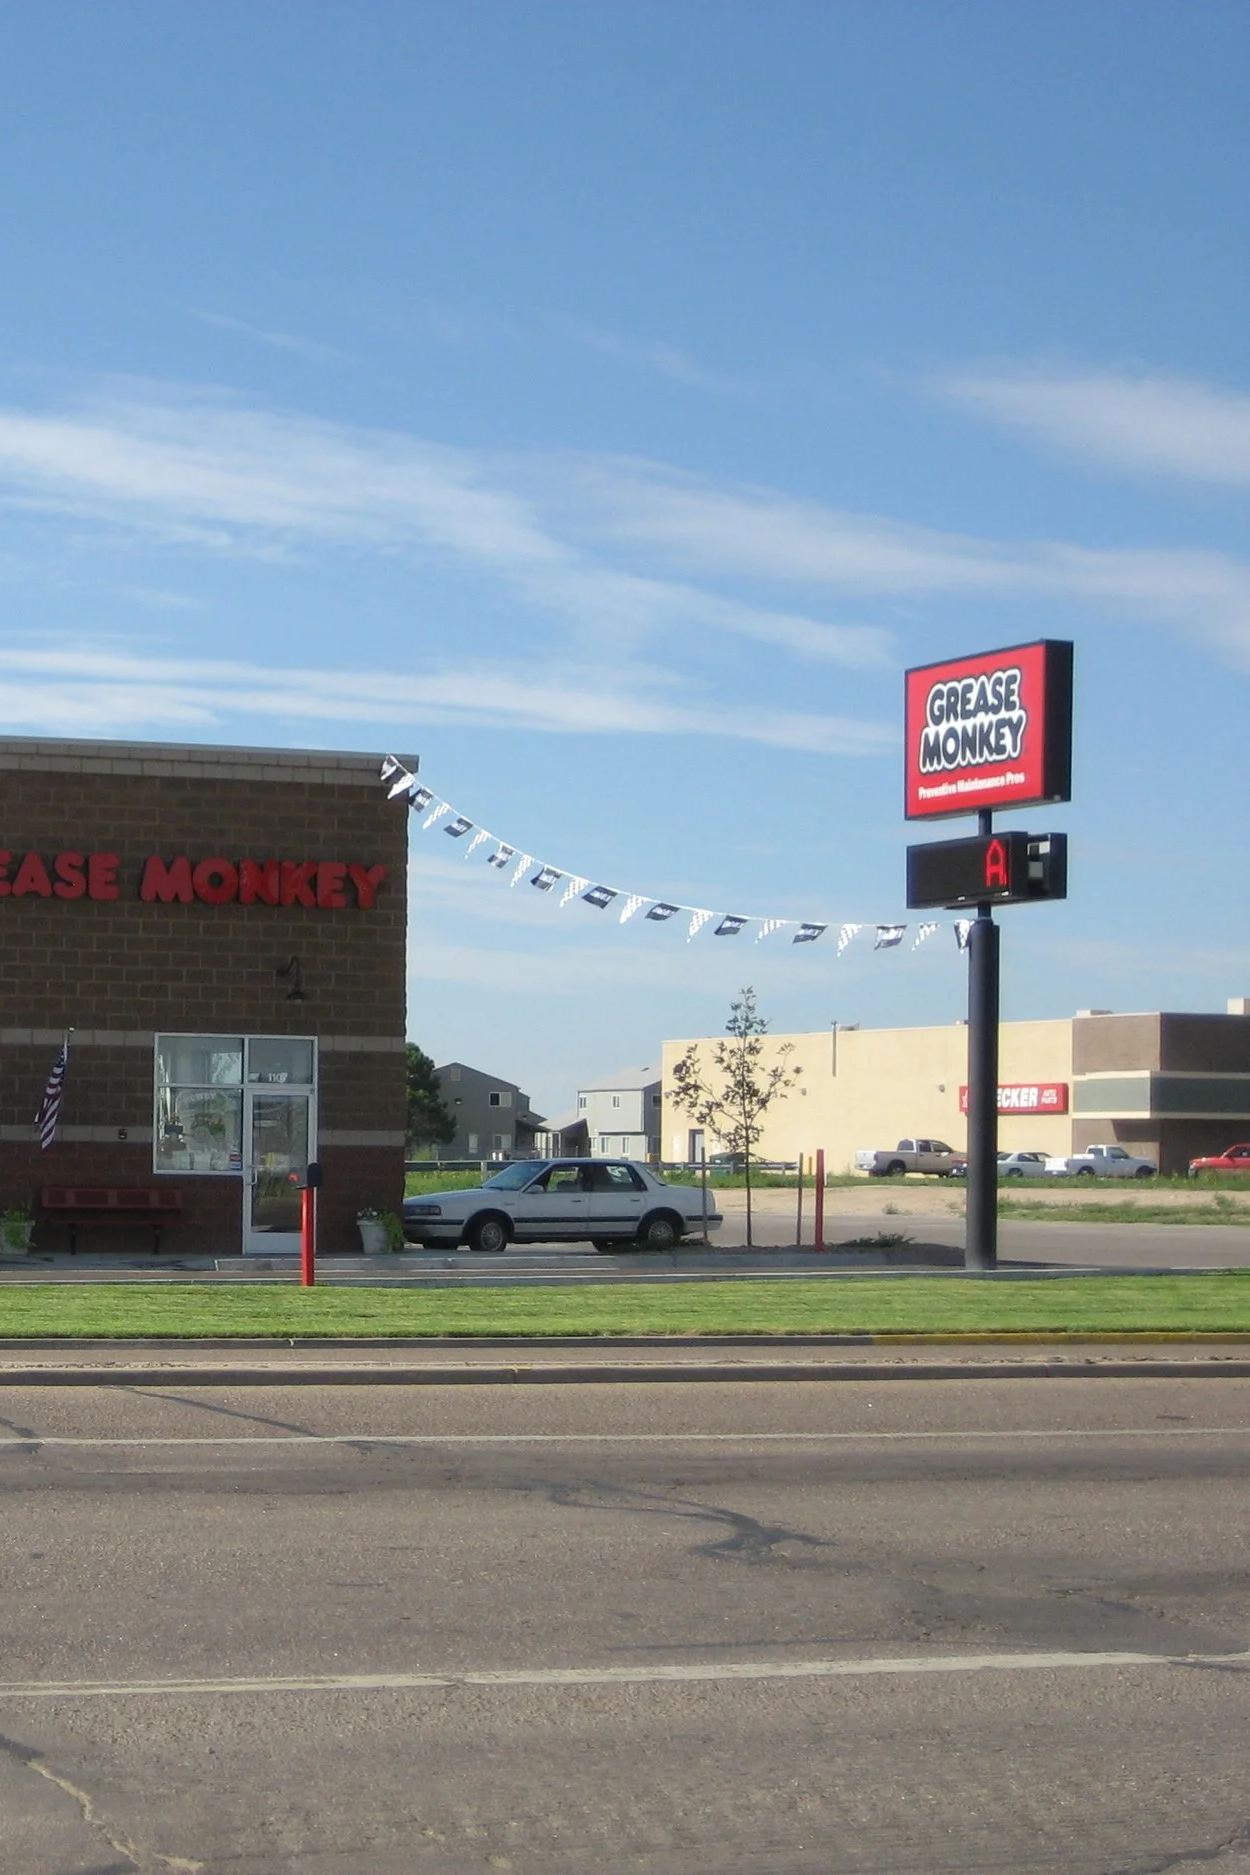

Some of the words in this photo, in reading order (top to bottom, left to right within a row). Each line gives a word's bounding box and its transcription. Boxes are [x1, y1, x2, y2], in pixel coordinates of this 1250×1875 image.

[926, 668, 1021, 728] GREASE
[919, 709, 1027, 774] MONKEY
[918, 783, 957, 800] Preventive
[957, 775, 1006, 793] Maintenance
[1006, 771, 1025, 786] Pros
[141, 857, 387, 909] MONKEY
[997, 1087, 1038, 1108] ECKER
